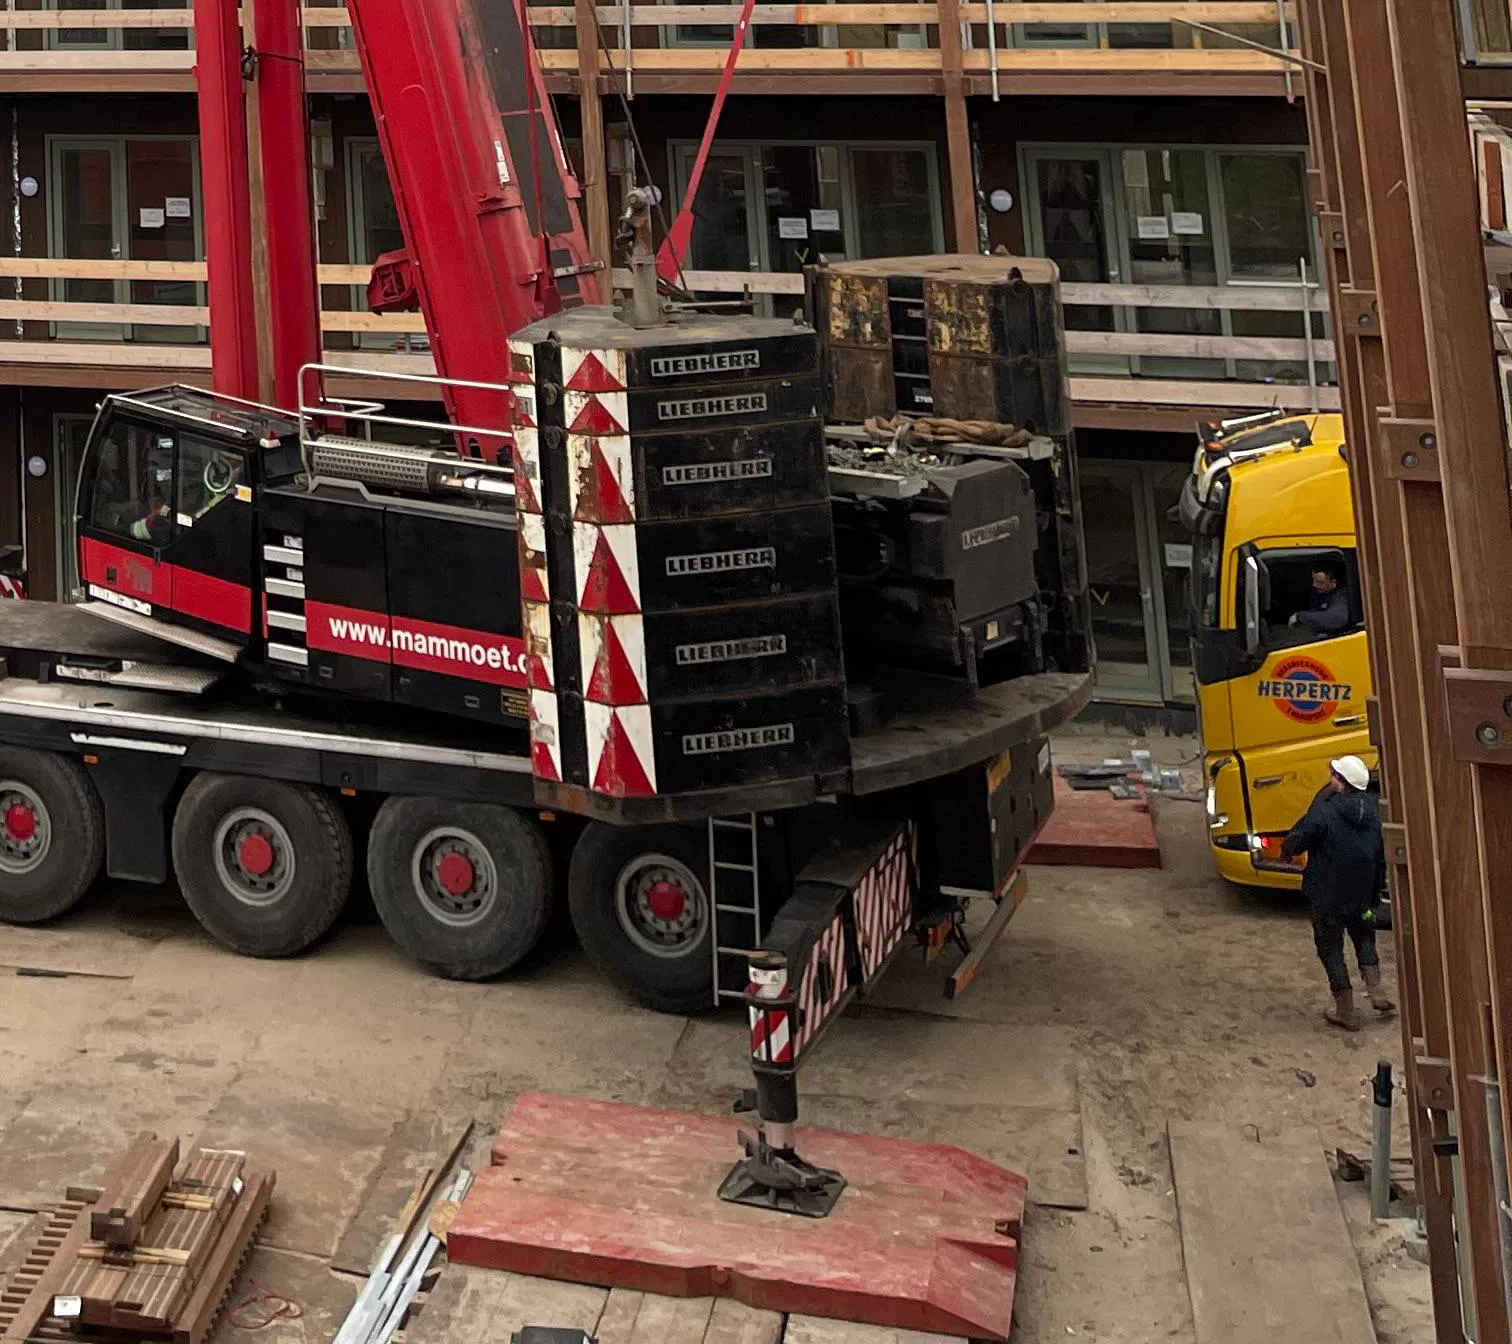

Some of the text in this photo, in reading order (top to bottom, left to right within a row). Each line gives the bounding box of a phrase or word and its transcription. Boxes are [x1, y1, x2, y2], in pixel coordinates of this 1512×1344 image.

[652, 351, 759, 375] LIEBHERR
[659, 394, 766, 419] LIEBHERR
[667, 548, 775, 575] LIEBHERR
[1257, 680, 1352, 701] HERPERTZ
[684, 724, 793, 754] LIEBHERR
